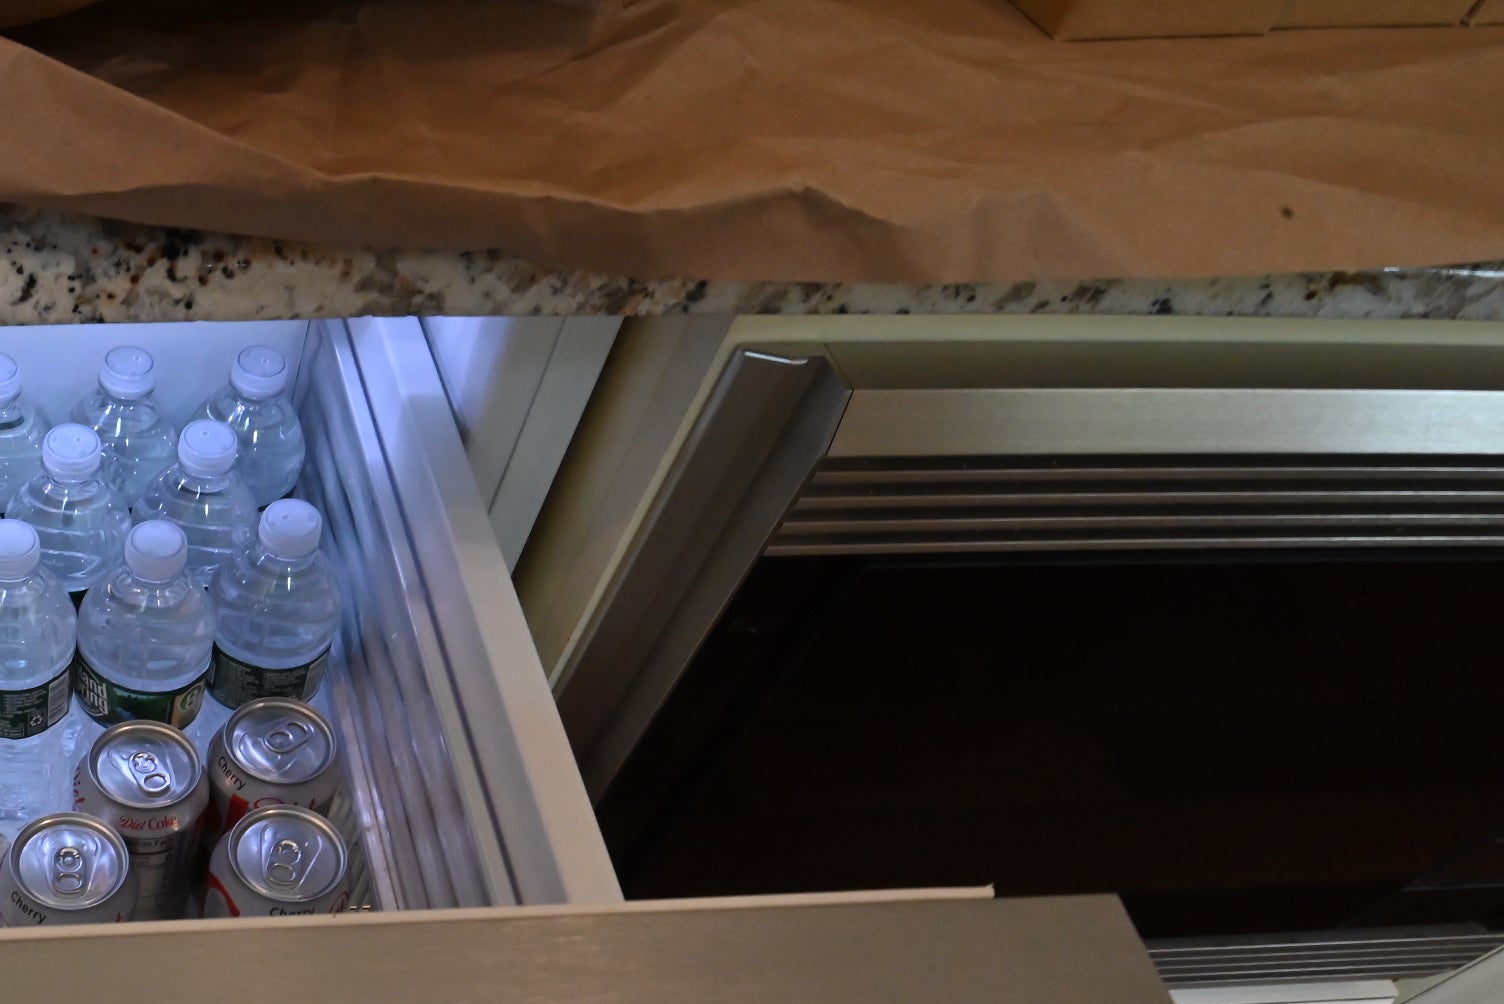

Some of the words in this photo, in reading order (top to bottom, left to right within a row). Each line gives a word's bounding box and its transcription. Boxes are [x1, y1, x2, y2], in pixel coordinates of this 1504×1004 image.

[217, 756, 246, 790] Cherry
[120, 815, 147, 830] Diet
[147, 815, 177, 831] Coke
[11, 891, 47, 924] Cherry
